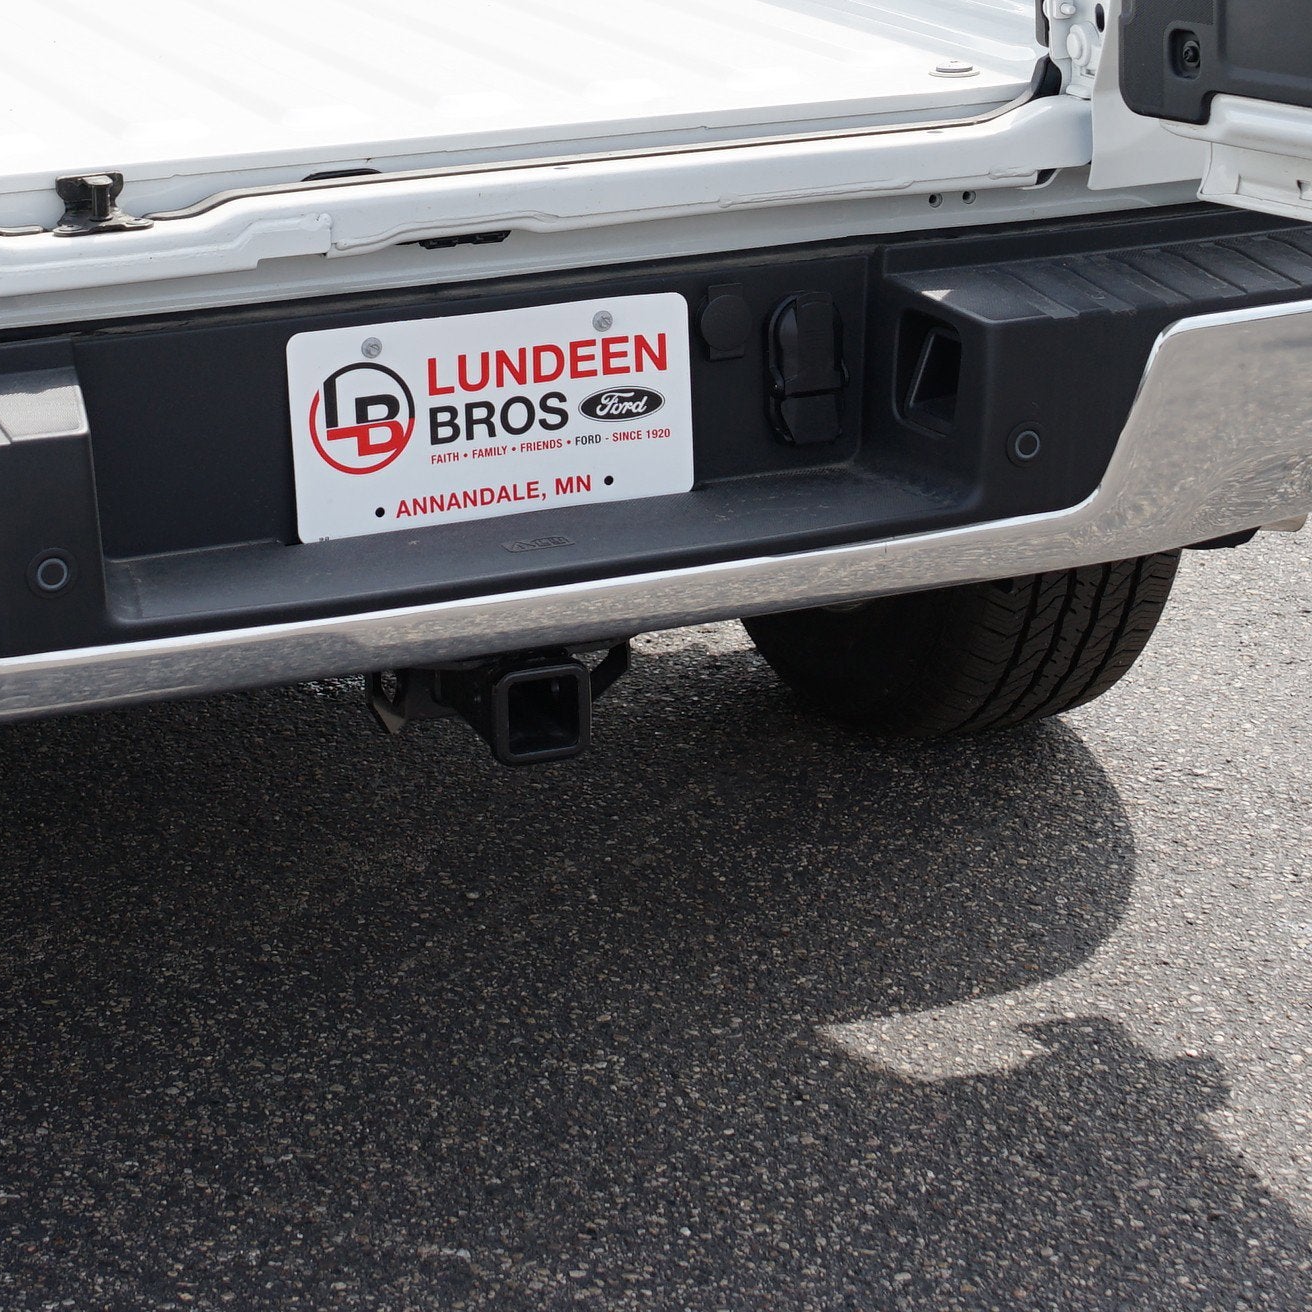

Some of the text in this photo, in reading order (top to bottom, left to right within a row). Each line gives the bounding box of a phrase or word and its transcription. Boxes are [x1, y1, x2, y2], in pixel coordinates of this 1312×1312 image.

[427, 333, 668, 396] LUNDEEN
[429, 391, 569, 446] BROS
[431, 452, 460, 465] FAITH
[472, 445, 508, 459] FAMILY
[520, 438, 563, 453] FRIENDS
[575, 433, 602, 446] FORD
[612, 430, 643, 442] SINCE
[646, 428, 671, 439] 1920
[396, 474, 592, 519] ANNANDALE, MN
